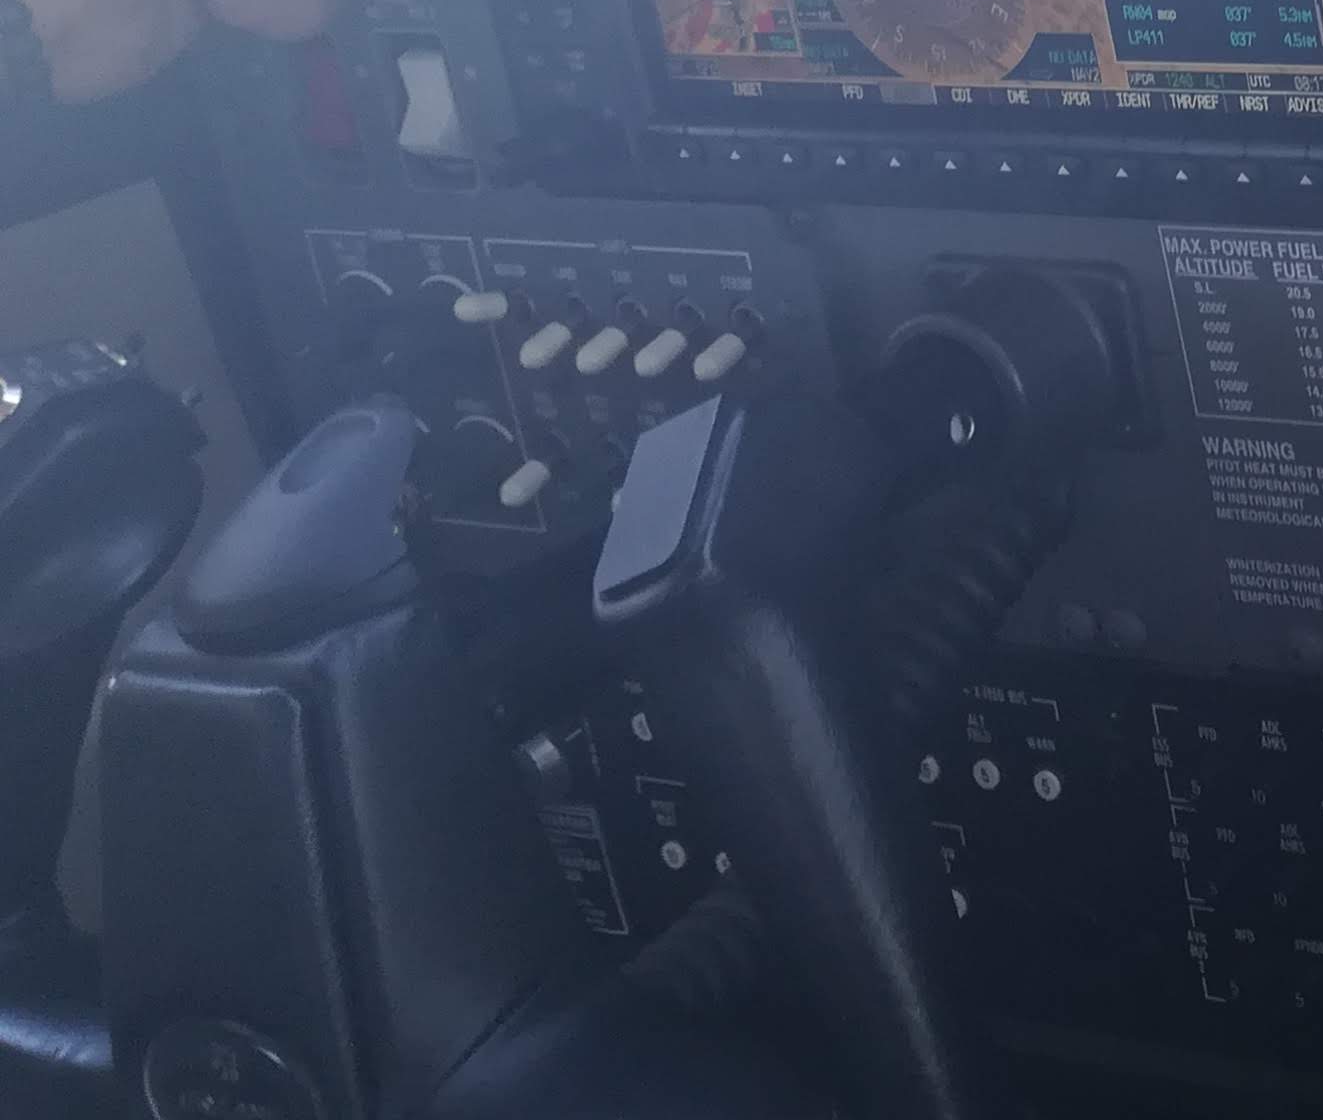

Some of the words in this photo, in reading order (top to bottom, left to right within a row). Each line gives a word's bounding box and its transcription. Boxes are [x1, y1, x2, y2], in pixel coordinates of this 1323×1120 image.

[1117, 94, 1151, 107] IDENT
[1164, 237, 1206, 254] MAX.
[1210, 240, 1273, 258] POWER
[1278, 242, 1322, 260] FUEL
[1202, 436, 1296, 460] WARNING
